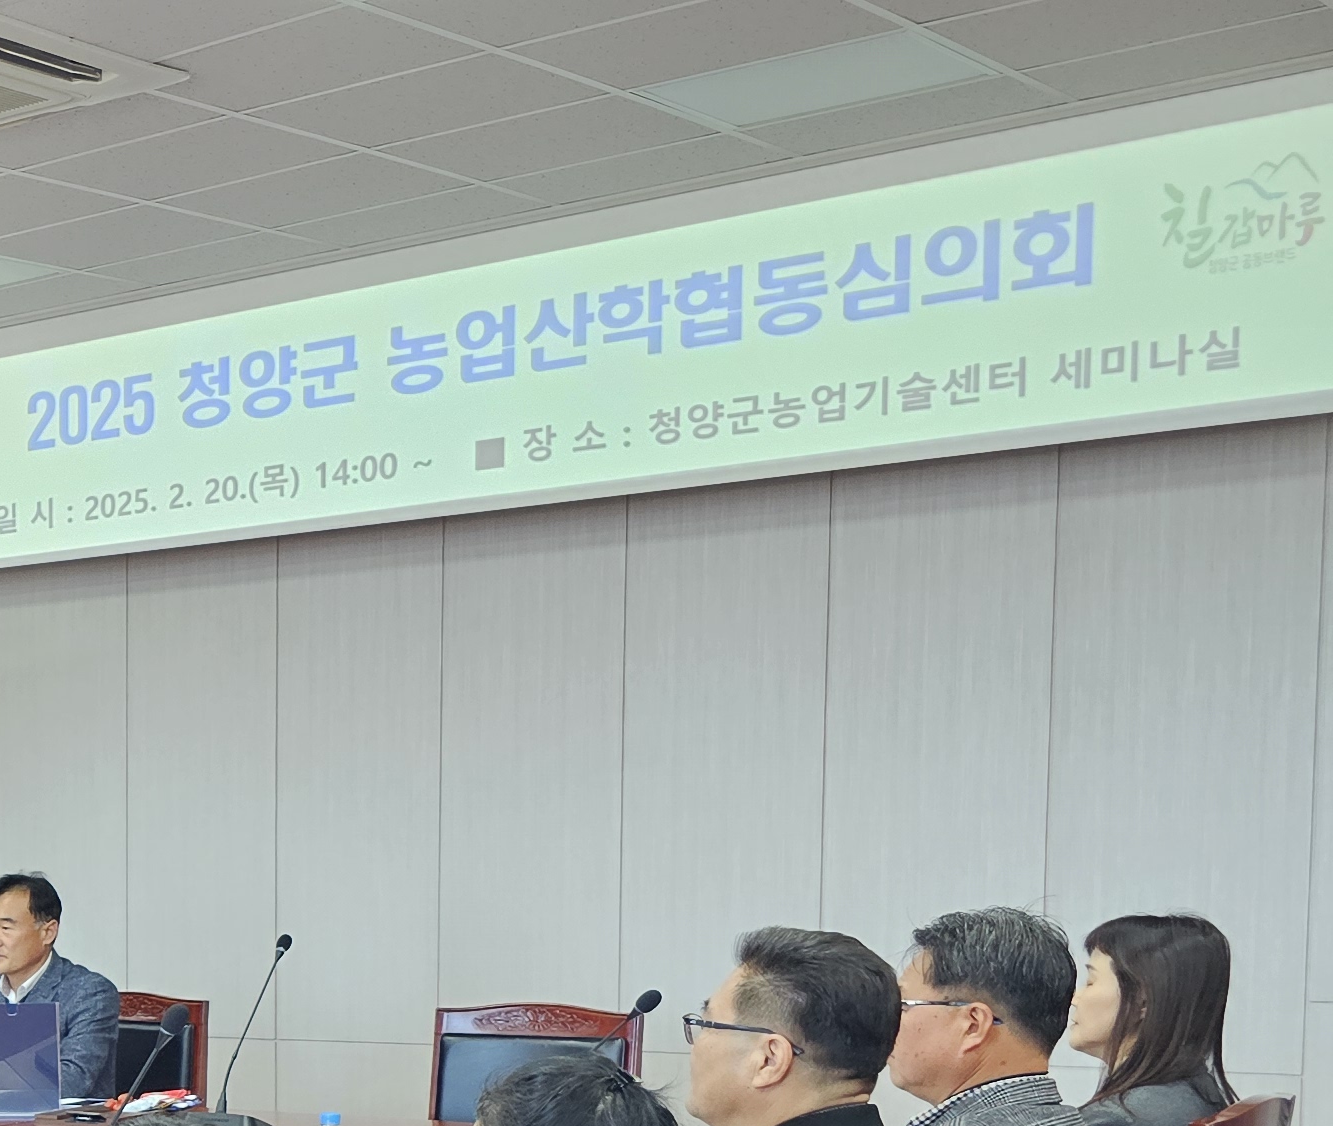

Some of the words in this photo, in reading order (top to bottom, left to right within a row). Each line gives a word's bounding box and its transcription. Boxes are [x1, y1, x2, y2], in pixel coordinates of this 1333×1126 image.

[27, 374, 155, 452] 2025
[178, 334, 359, 429] 청양군
[386, 201, 1096, 395] 농업산학협동심의회
[648, 356, 1028, 446] 청양군농업기술센터
[1049, 325, 1242, 391] 세미나실
[85, 488, 157, 522] 2025.
[169, 482, 194, 512] 2.
[204, 463, 300, 503] 20.(목)
[314, 452, 398, 489] 14:00
